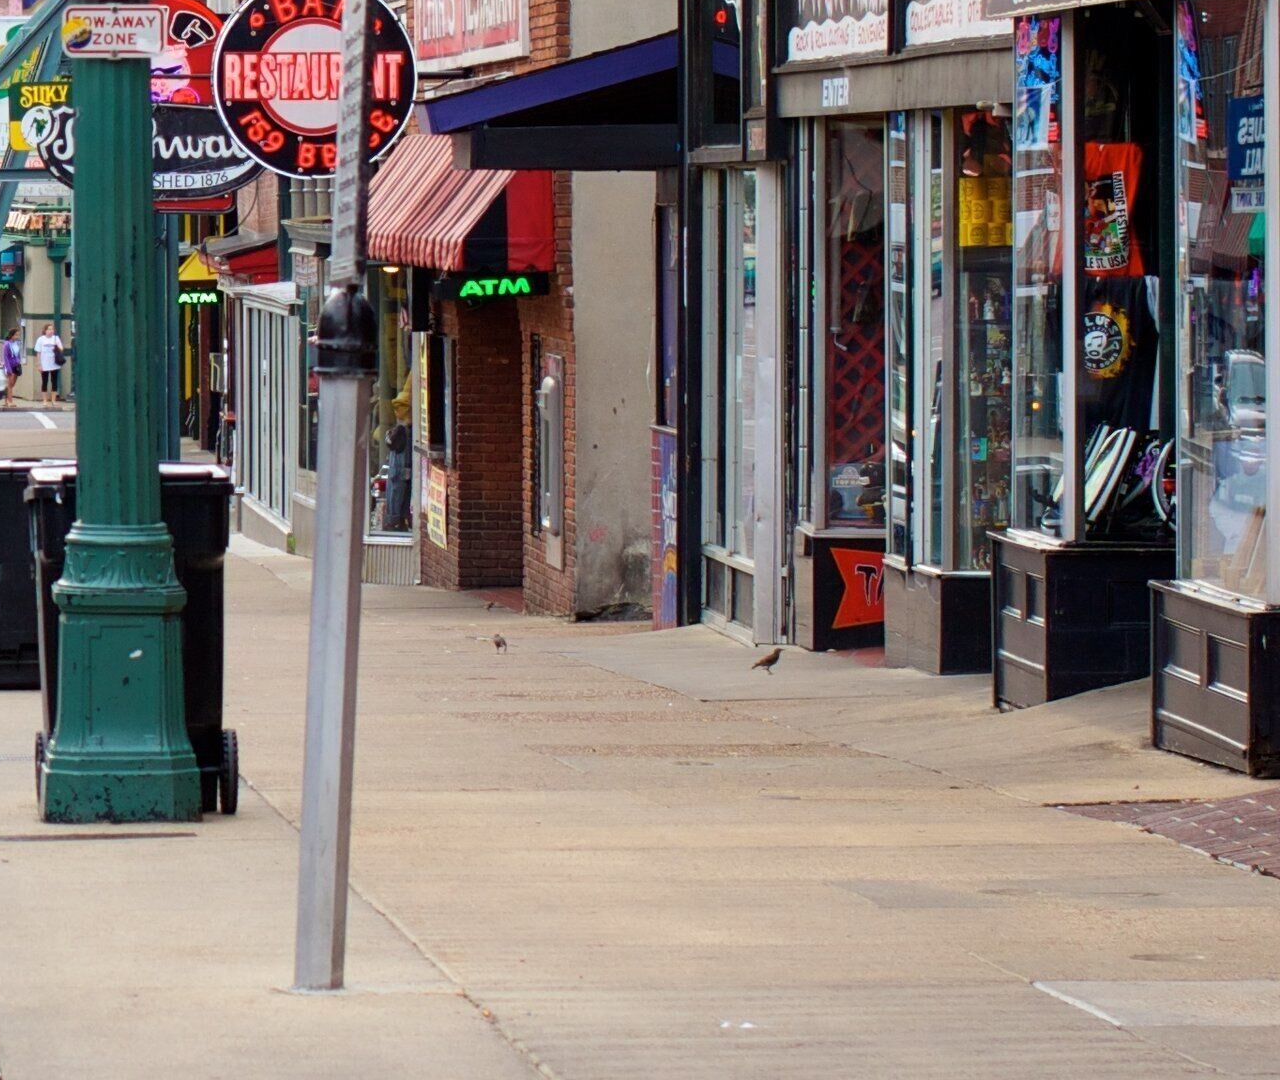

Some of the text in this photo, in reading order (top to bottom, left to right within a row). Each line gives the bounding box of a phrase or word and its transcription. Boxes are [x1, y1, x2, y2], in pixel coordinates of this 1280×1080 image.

[93, 33, 137, 45] ZONE
[20, 84, 69, 109] SILKY
[822, 77, 849, 107] ENTER
[154, 172, 228, 188] SHED 1876
[1114, 172, 1125, 206] MUSIC
[1109, 255, 1127, 267] USA
[460, 277, 531, 298] ATM
[178, 292, 218, 304] ATM
